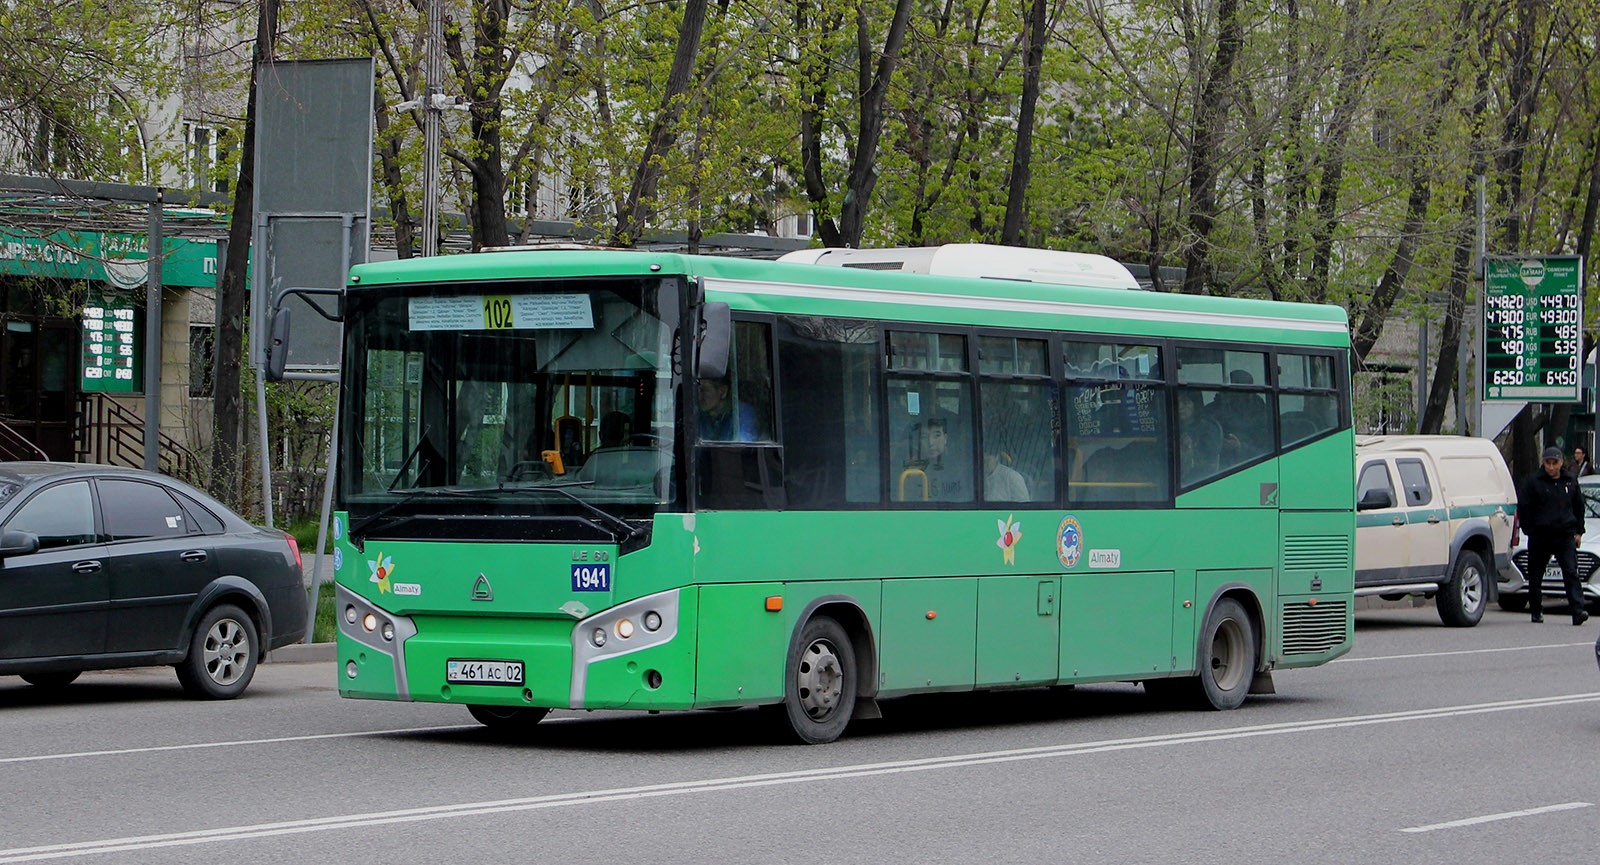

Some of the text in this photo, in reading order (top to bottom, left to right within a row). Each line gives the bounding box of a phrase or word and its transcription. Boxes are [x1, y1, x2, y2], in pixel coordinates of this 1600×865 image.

[485, 299, 512, 328] 102
[1526, 312, 1537, 320] EUR
[1525, 327, 1537, 335] RUB
[1525, 343, 1537, 351] KGS
[1515, 355, 1577, 370] 0 GBP 0
[1525, 374, 1537, 382] CNY
[571, 550, 609, 561] LE 60
[1091, 552, 1119, 564] Almaty
[574, 567, 606, 588] 1941
[394, 585, 419, 593] Almaty
[461, 664, 483, 679] 461
[487, 668, 501, 680] AC
[506, 665, 521, 680] 02
